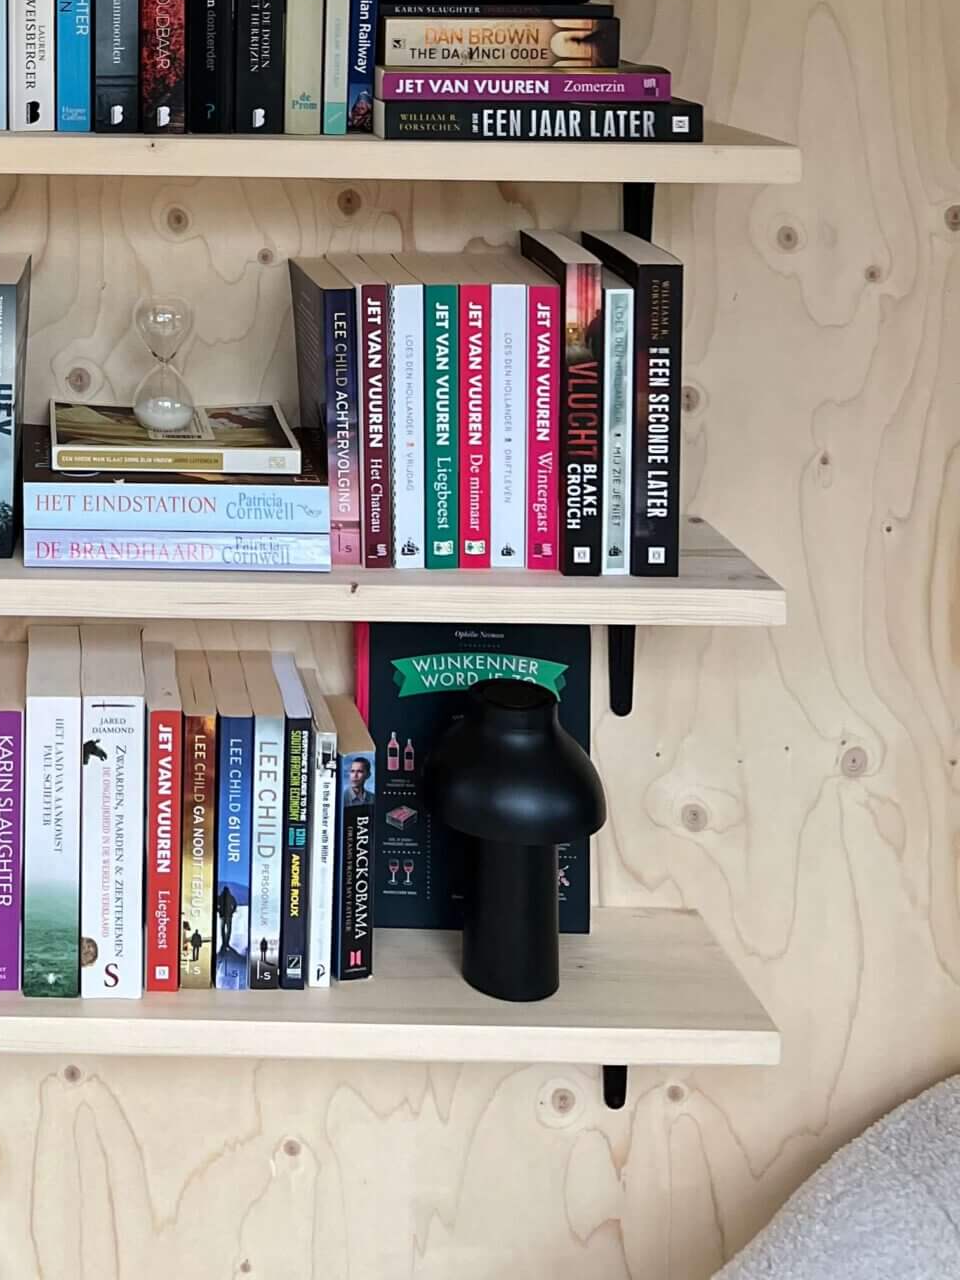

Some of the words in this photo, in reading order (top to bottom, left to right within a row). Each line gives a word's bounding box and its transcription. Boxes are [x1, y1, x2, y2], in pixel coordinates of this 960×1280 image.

[355, 24, 371, 73] Railway
[396, 80, 422, 93] JET
[429, 80, 469, 93] VAN
[475, 80, 549, 93] VUUREN
[564, 81, 625, 92] Zomerzin
[483, 110, 522, 136] EEN
[529, 110, 581, 137] JAAR
[590, 111, 655, 137] LATER
[649, 359, 669, 386] EEN
[568, 361, 598, 459] VLUCHT
[648, 393, 669, 463] SECONDE
[567, 464, 580, 529] CROUCH
[584, 464, 597, 516] BLAKE
[647, 471, 669, 517] LATER
[413, 655, 538, 675] WIJNKENNER
[422, 671, 479, 688] WORD
[158, 724, 172, 752] JET
[229, 739, 241, 765] LEE
[158, 756, 172, 794] VAN
[229, 769, 241, 812] CHILD
[157, 800, 171, 872] VUUREN
[228, 817, 240, 830] 61
[228, 833, 240, 861] UUR
[356, 817, 368, 880] BARACK
[156, 890, 170, 949] Liegbeest
[355, 882, 367, 939] OBAMA
